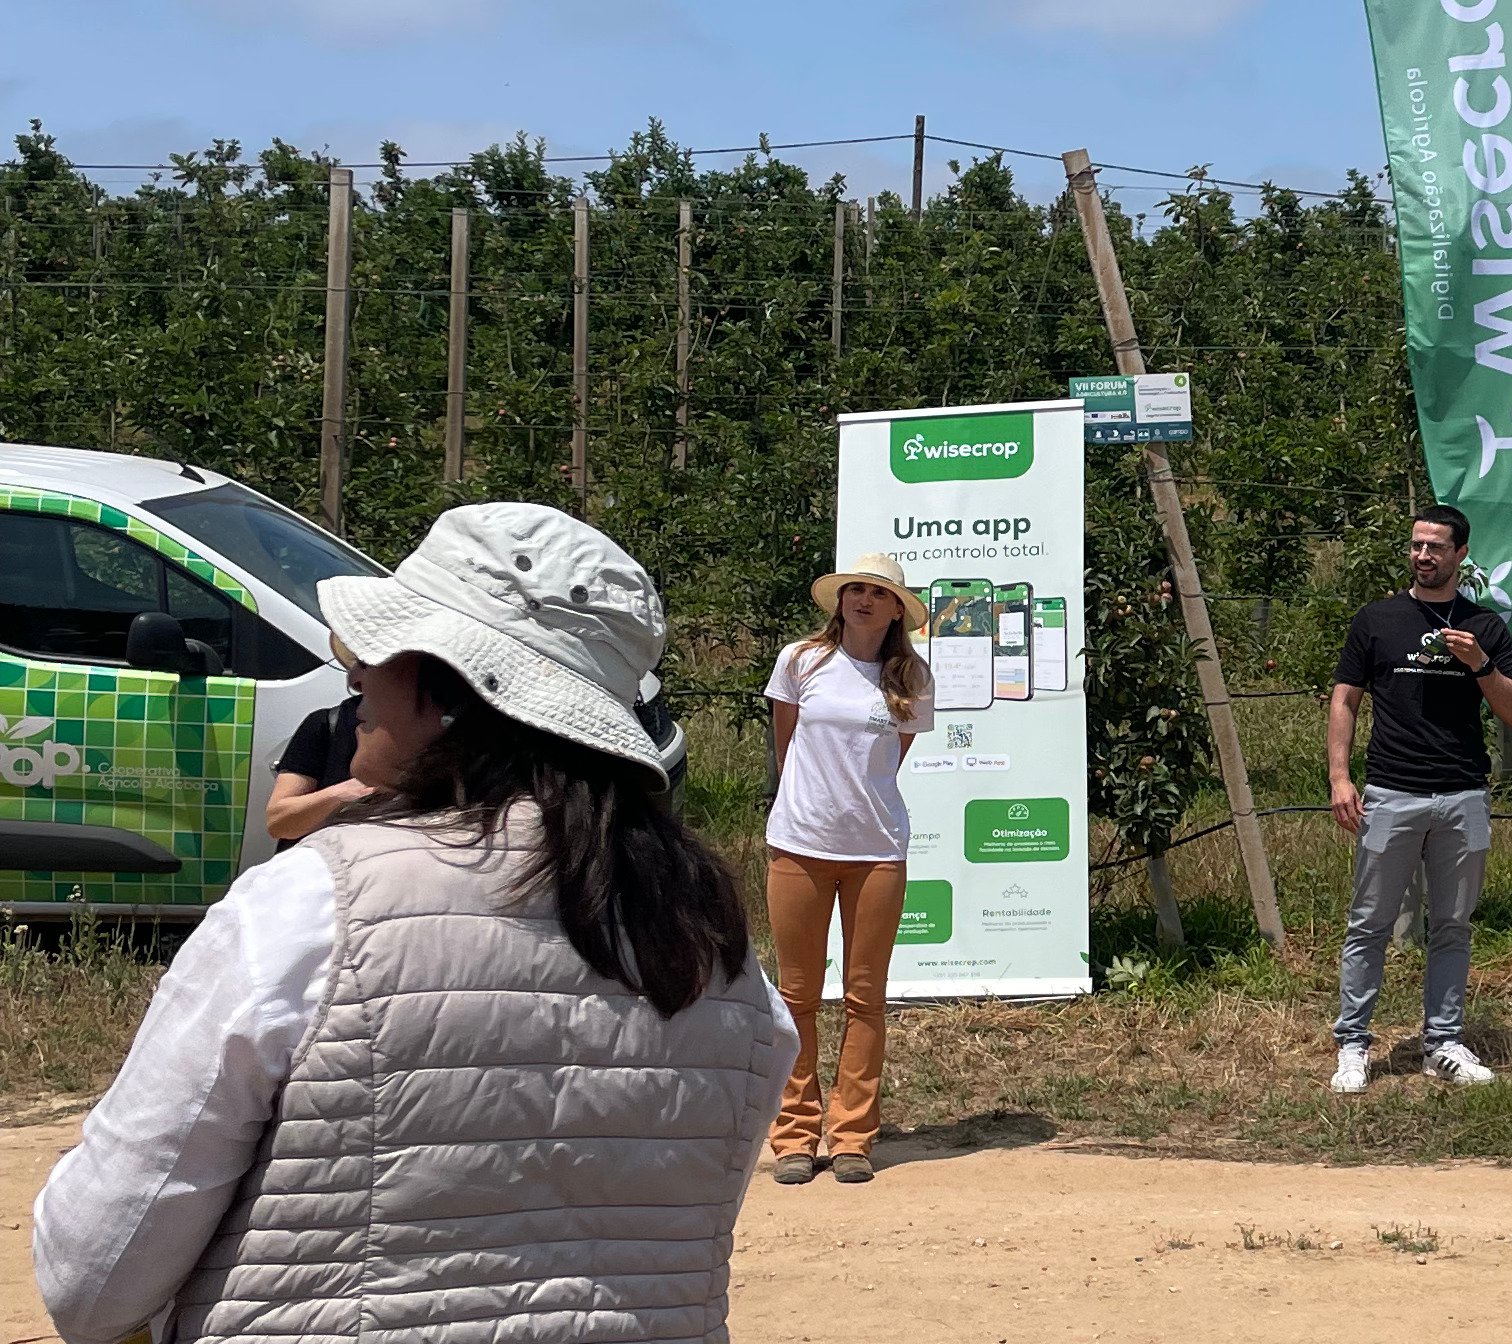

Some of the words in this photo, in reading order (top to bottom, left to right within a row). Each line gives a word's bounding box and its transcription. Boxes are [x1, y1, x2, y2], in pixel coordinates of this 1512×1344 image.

[923, 441, 1019, 460] wisecrop
[893, 516, 963, 540] Uma
[972, 517, 1032, 542] app
[884, 550, 918, 562] ara
[922, 543, 998, 560] controlo
[1002, 541, 1050, 558] total.
[97, 761, 181, 777] Cooperativa
[991, 828, 1049, 839] Otimização
[982, 908, 1052, 918] Rentabilidade
[917, 959, 997, 967] www.wisecrop.com
